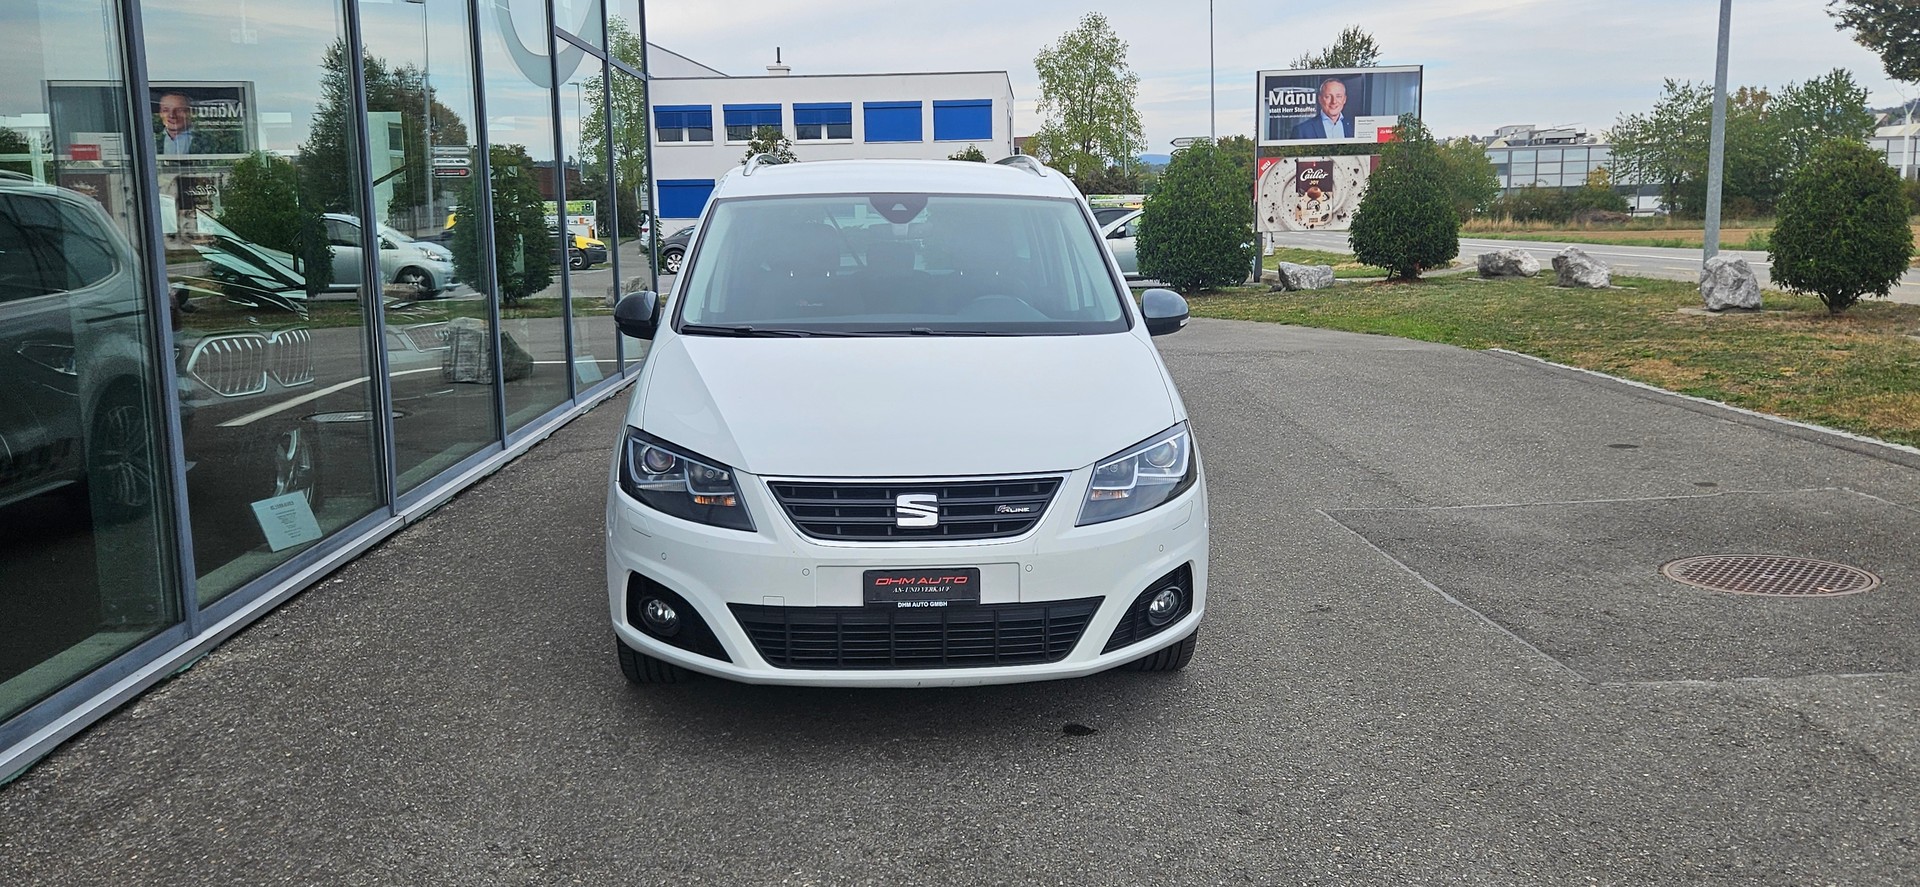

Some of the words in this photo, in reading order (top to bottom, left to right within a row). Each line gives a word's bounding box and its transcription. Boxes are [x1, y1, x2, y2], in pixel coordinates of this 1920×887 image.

[1269, 90, 1316, 105] Mänu
[1261, 160, 1271, 171] NEU
[1300, 168, 1328, 181] Cailler
[917, 576, 968, 585] AUTO
